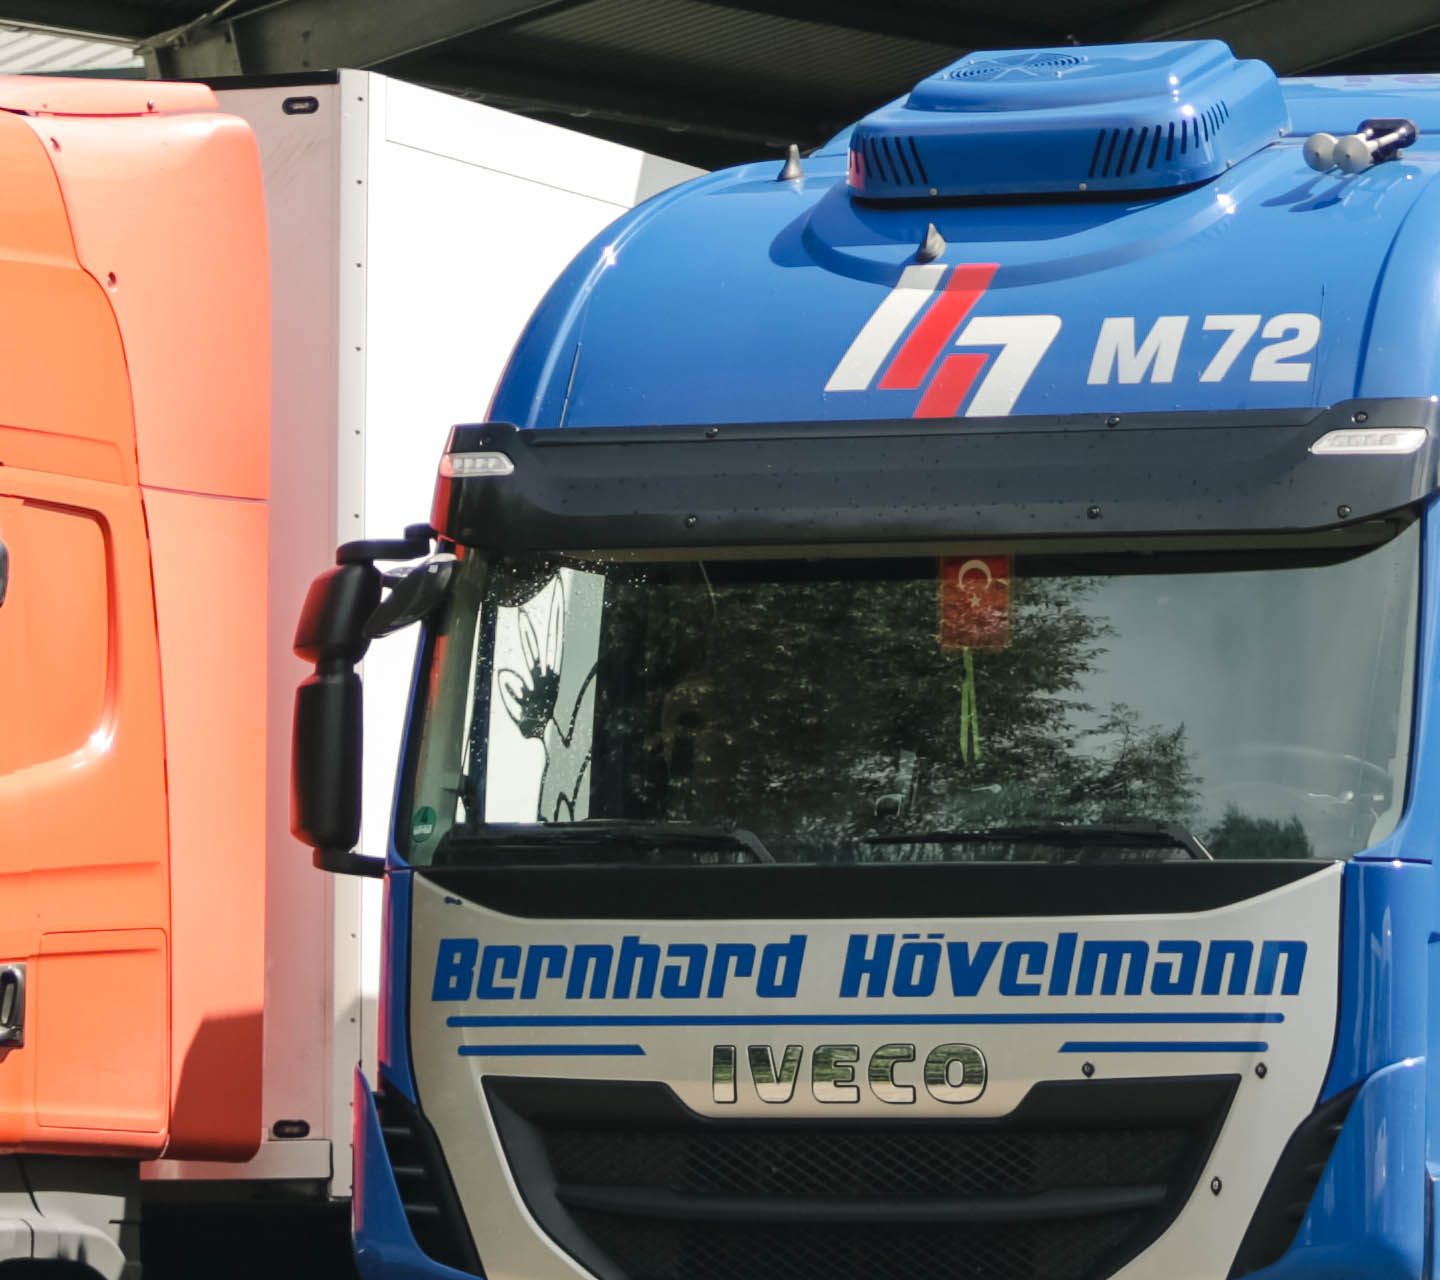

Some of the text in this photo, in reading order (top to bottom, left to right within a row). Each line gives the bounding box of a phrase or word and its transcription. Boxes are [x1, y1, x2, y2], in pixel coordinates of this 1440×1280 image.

[1086, 312, 1322, 385] M 72
[431, 932, 1308, 1002] Bernhard Hövelmann
[711, 1043, 989, 1105] IVECO
